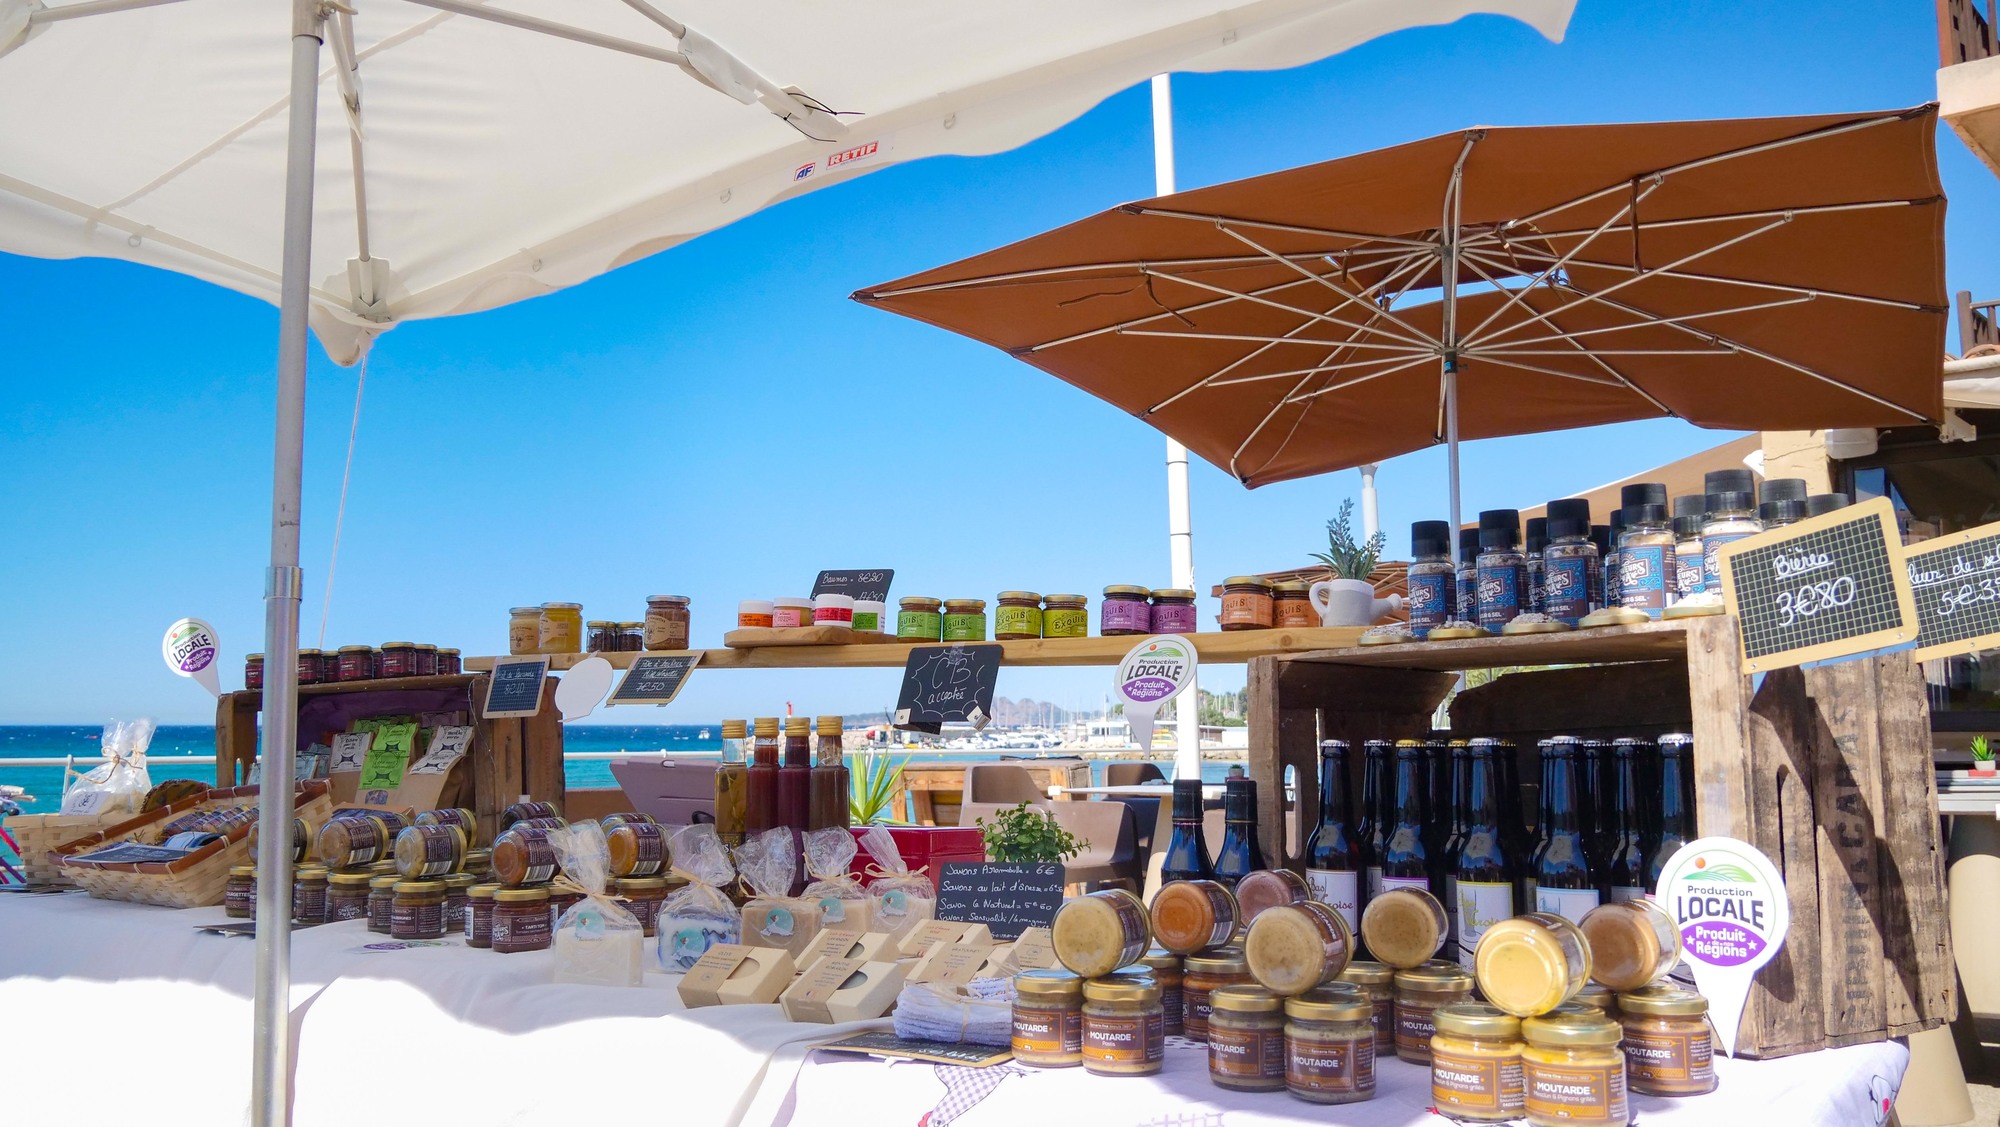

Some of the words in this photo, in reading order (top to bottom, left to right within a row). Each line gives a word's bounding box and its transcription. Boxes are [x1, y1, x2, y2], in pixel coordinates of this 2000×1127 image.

[828, 142, 878, 167] RETIF
[796, 165, 814, 180] AF
[1952, 556, 1975, 575] de
[1775, 576, 1854, 627] 3€80
[173, 633, 212, 665] LOCALE
[931, 656, 972, 689] CB
[1126, 664, 1184, 682] LOCALE
[1134, 680, 1166, 689] Produit
[1131, 687, 1163, 698] Régions
[942, 880, 973, 893] Savons
[991, 881, 1007, 893] lait
[1687, 884, 1753, 897] Production
[938, 898, 966, 911] Savon
[1677, 895, 1765, 931] LOCALE
[1695, 925, 1747, 943] Produit
[1695, 940, 1748, 959] Régions
[1014, 1021, 1049, 1033] MOUTARDE
[1402, 1020, 1437, 1032] MOUTAR
[1089, 1030, 1131, 1041] MOUTARDE
[1208, 1040, 1246, 1054] MOUTARDE
[1625, 1045, 1671, 1059] MOUTARDE
[1293, 1055, 1339, 1068] MOUTARDE
[1435, 1068, 1480, 1084] MOUTARDE
[1450, 1081, 1469, 1090] Pignons
[1536, 1081, 1591, 1095] MOUTARDE
[1558, 1094, 1579, 1103] Pignons
[1579, 1096, 1596, 1104] grillés
